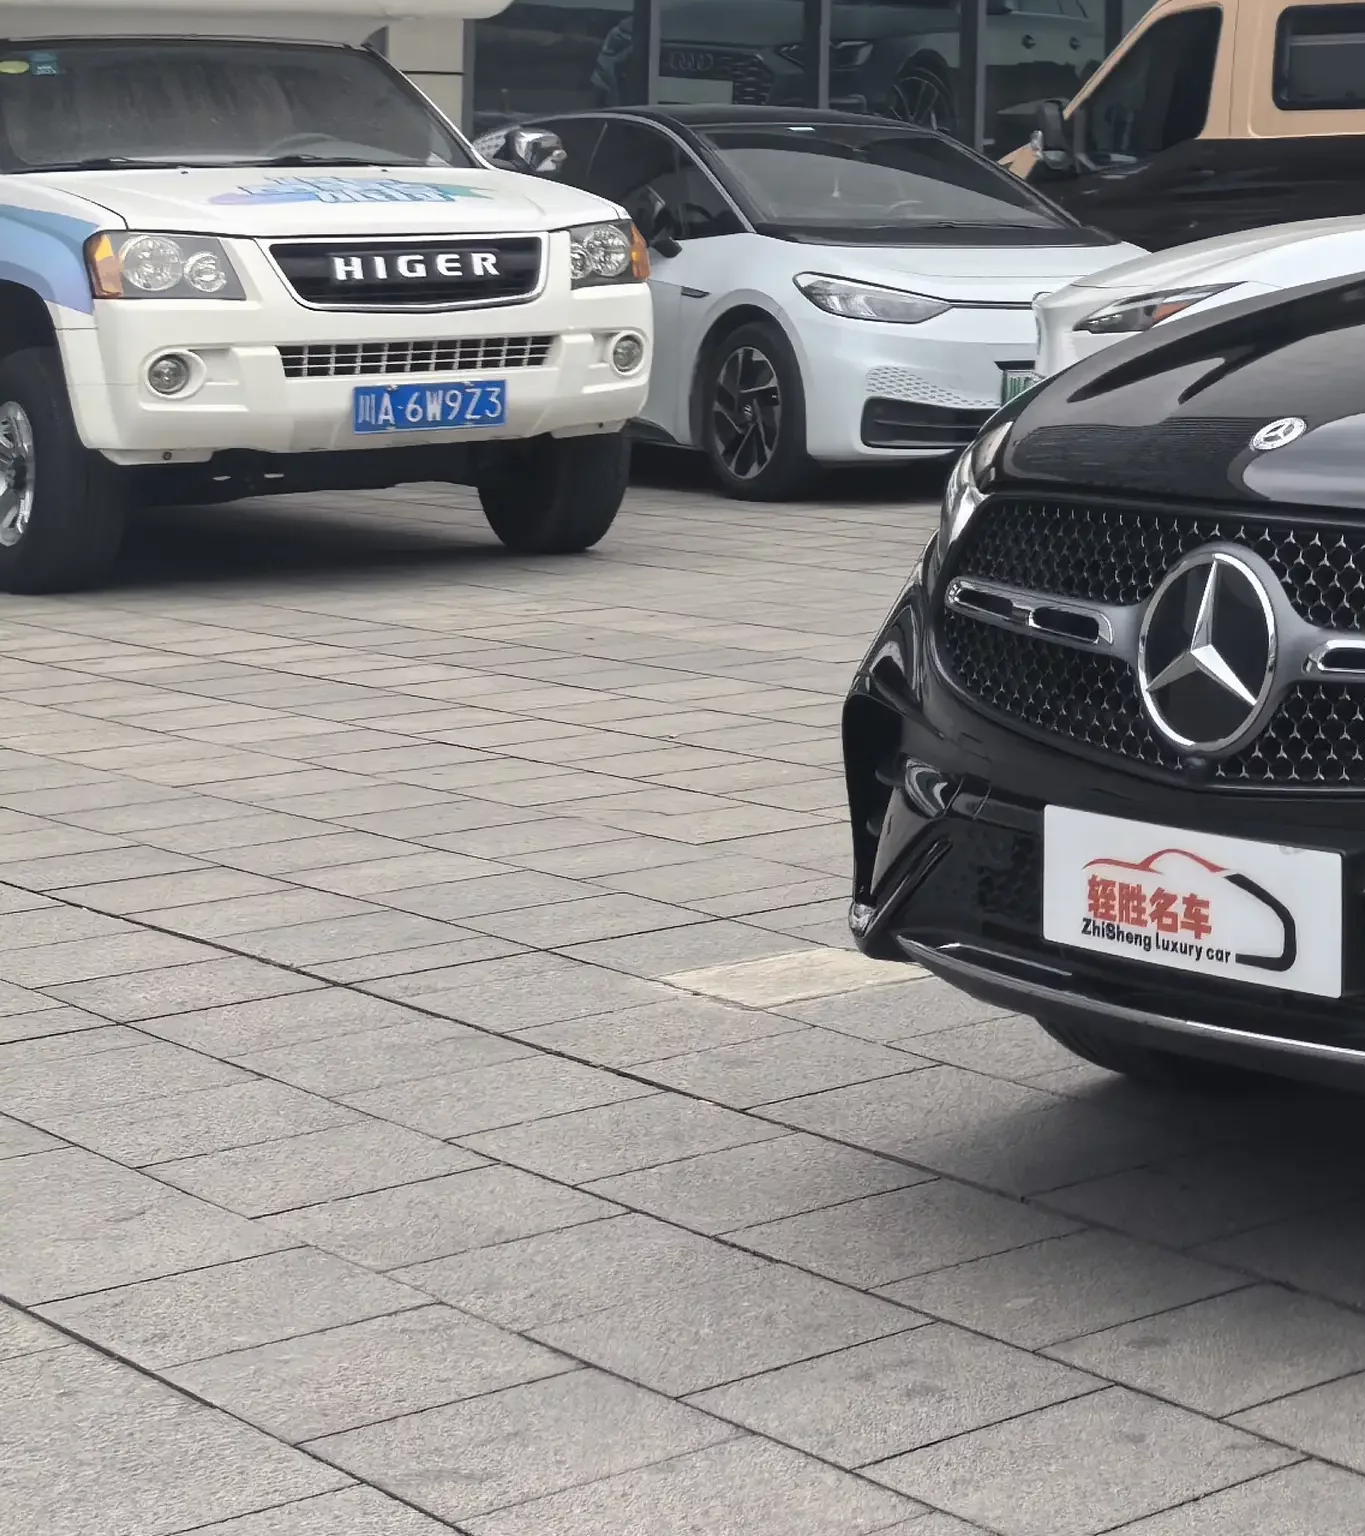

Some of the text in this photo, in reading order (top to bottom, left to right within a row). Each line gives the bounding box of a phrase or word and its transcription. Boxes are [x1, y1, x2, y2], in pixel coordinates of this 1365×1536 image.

[333, 252, 500, 281] HIGER
[1081, 917, 1231, 964] ZhiSheng luxury car
